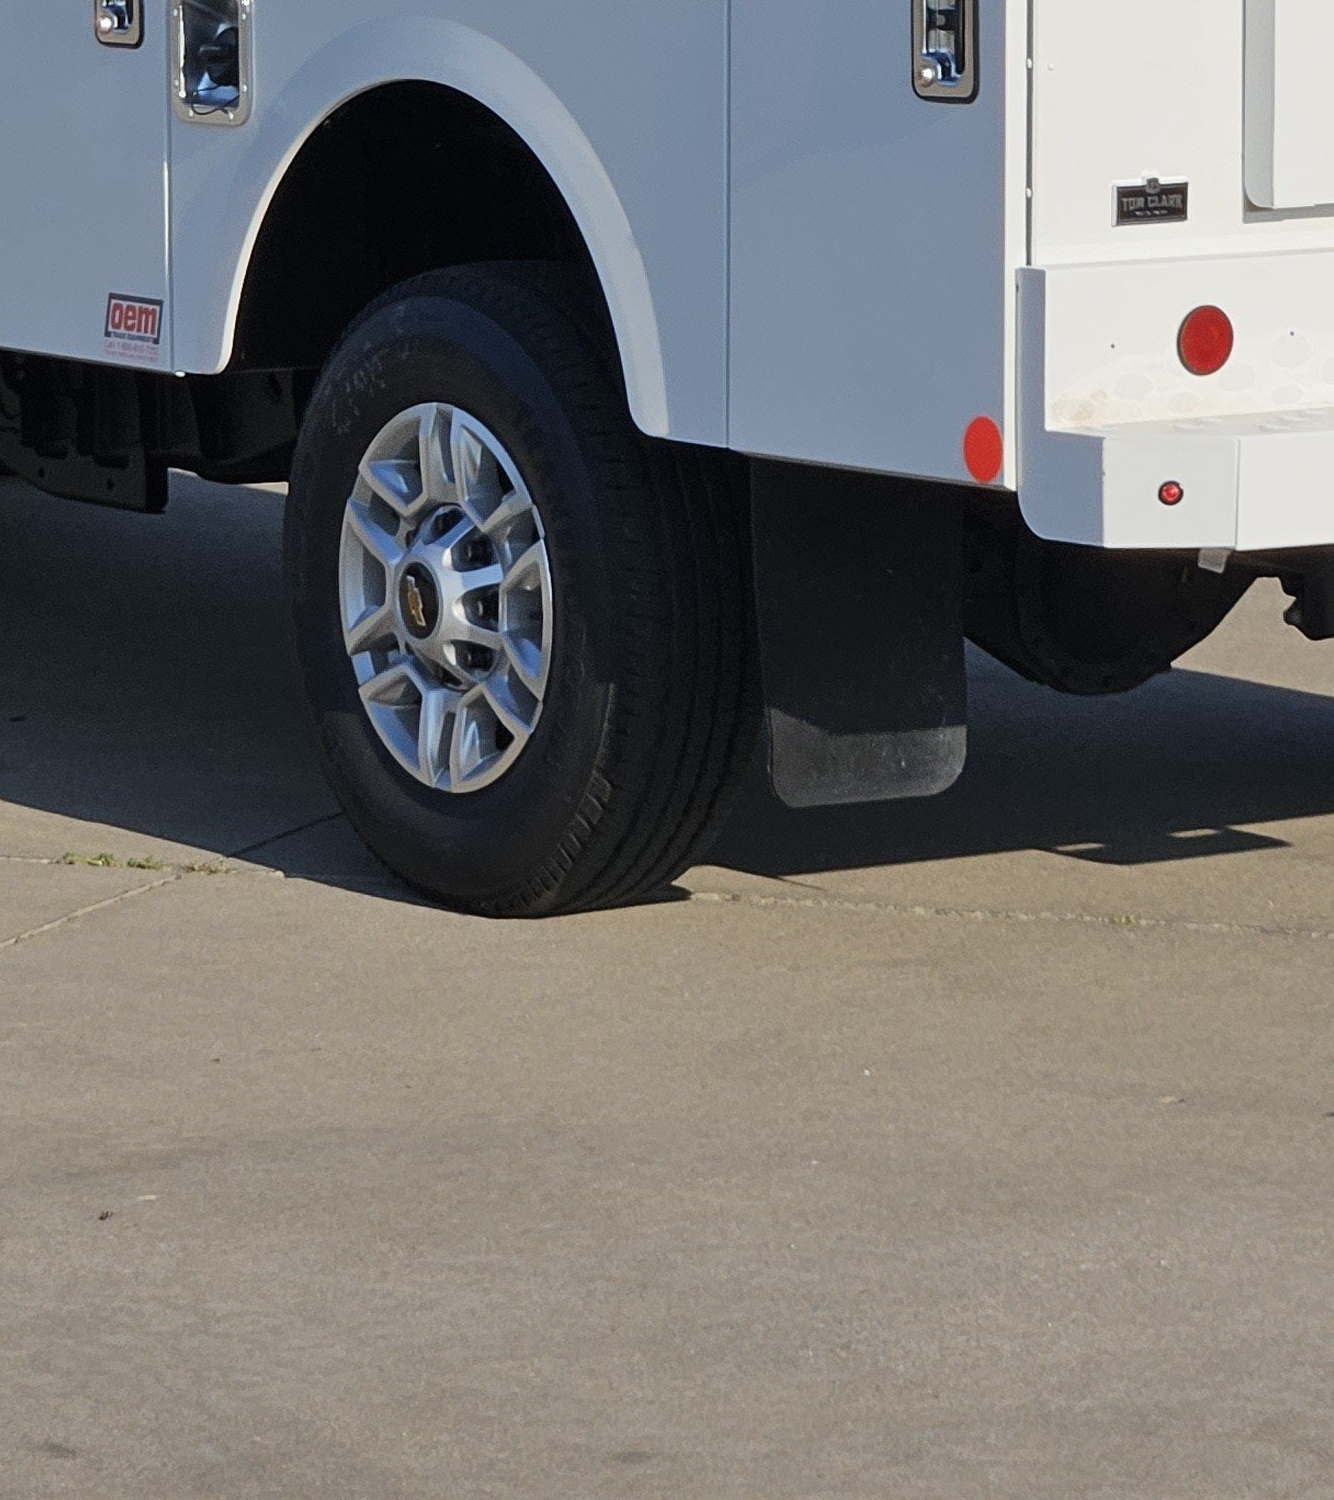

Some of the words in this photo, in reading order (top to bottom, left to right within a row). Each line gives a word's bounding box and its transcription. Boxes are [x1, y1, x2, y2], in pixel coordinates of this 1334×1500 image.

[1121, 197, 1145, 211] TOM
[1147, 194, 1183, 208] CLARK
[111, 303, 157, 334] oem
